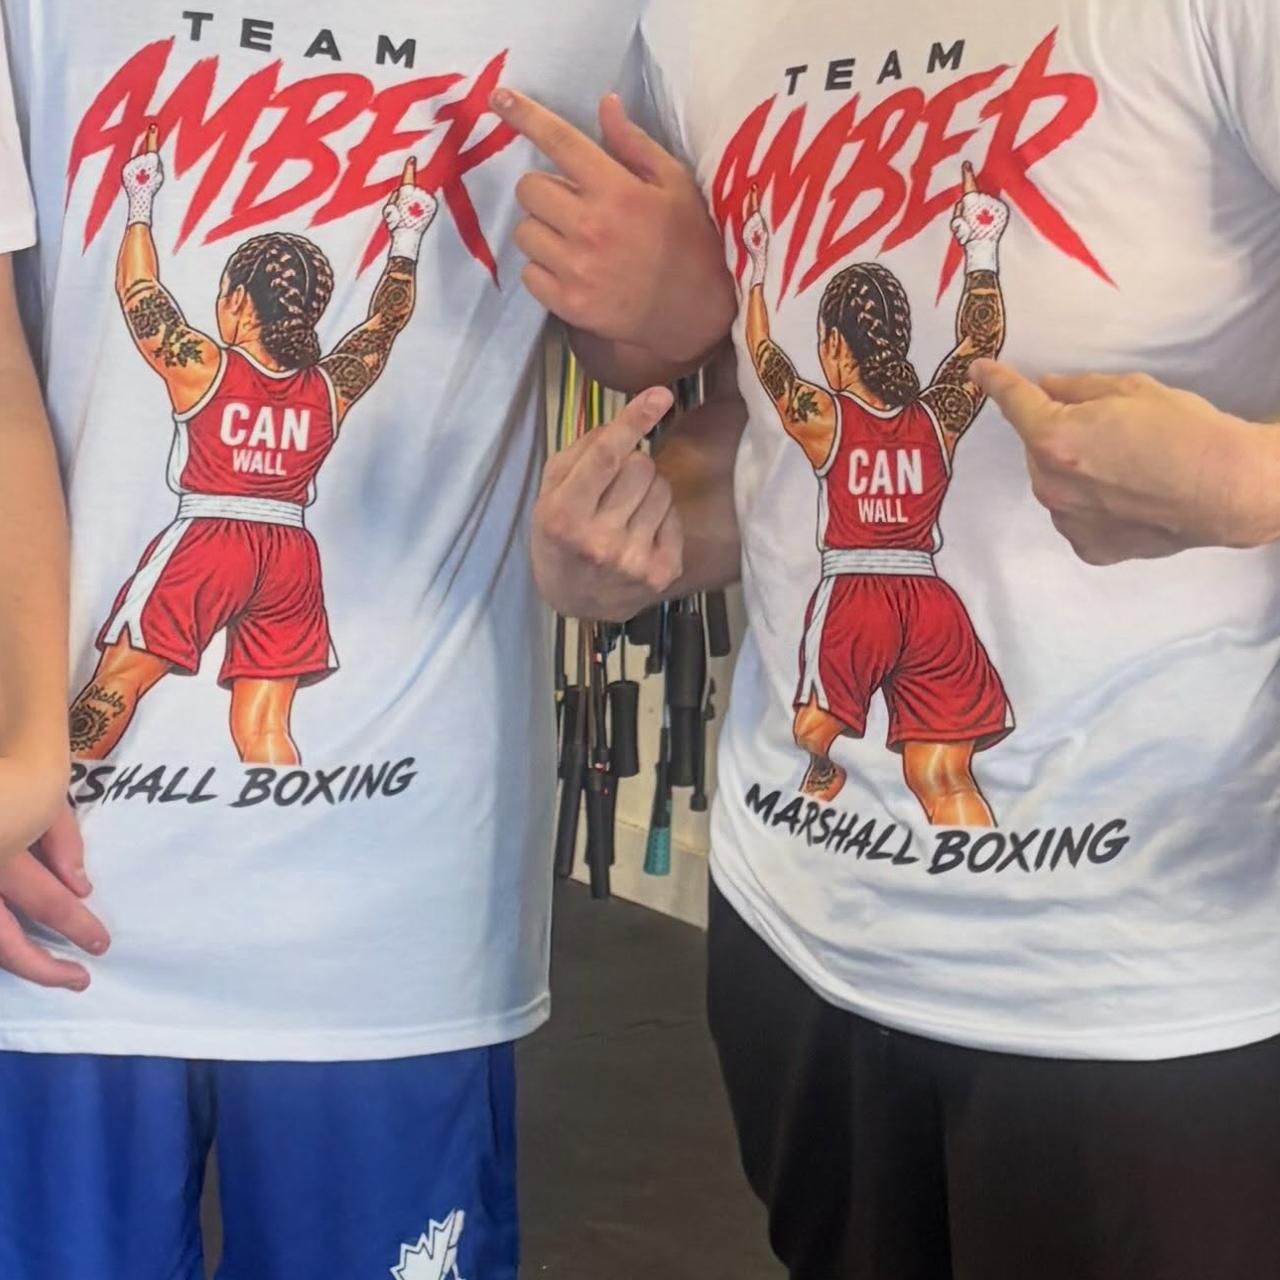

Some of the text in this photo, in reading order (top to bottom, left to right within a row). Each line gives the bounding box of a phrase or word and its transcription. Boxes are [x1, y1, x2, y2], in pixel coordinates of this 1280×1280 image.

[181, 10, 418, 69] TEAM
[784, 39, 966, 96] TEAM
[64, 34, 521, 293] AMBER
[712, 24, 1120, 314] AMBER
[219, 402, 311, 452] CAN
[232, 449, 287, 477] WALL
[847, 448, 923, 496] CAN
[857, 498, 908, 525] WALL
[67, 756, 421, 810] SHALL BOXING
[744, 782, 1131, 876] MARSHALL BOXING
